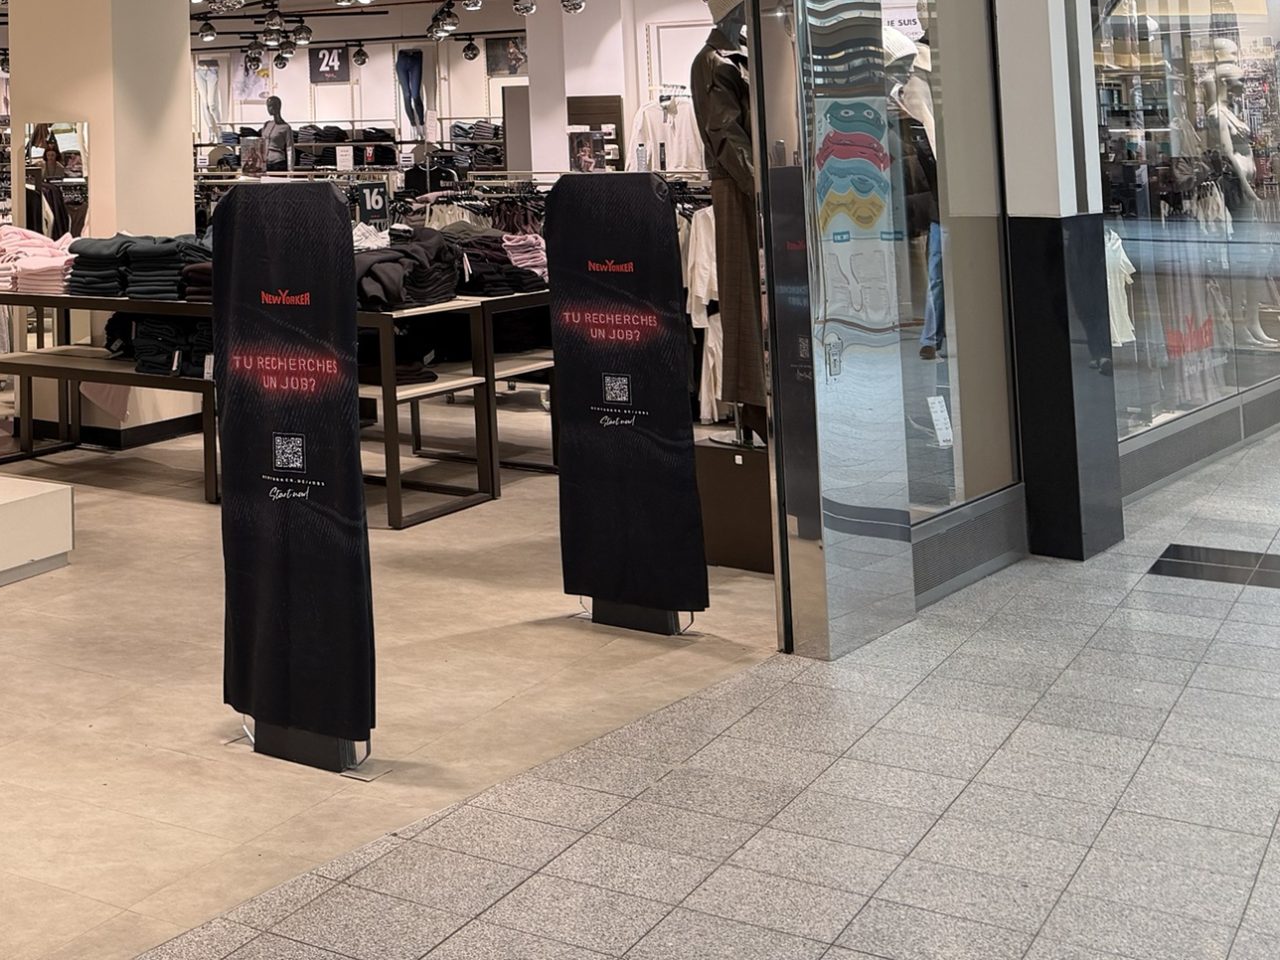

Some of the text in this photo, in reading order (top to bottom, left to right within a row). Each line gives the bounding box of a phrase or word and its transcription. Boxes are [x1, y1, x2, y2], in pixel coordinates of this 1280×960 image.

[898, 19, 917, 27] SUIS
[563, 312, 658, 327] TU RECHERCHES
[590, 328, 641, 341] UN JOB?
[233, 356, 337, 374] TU RECHERCHES
[262, 376, 316, 392] UN JOB?
